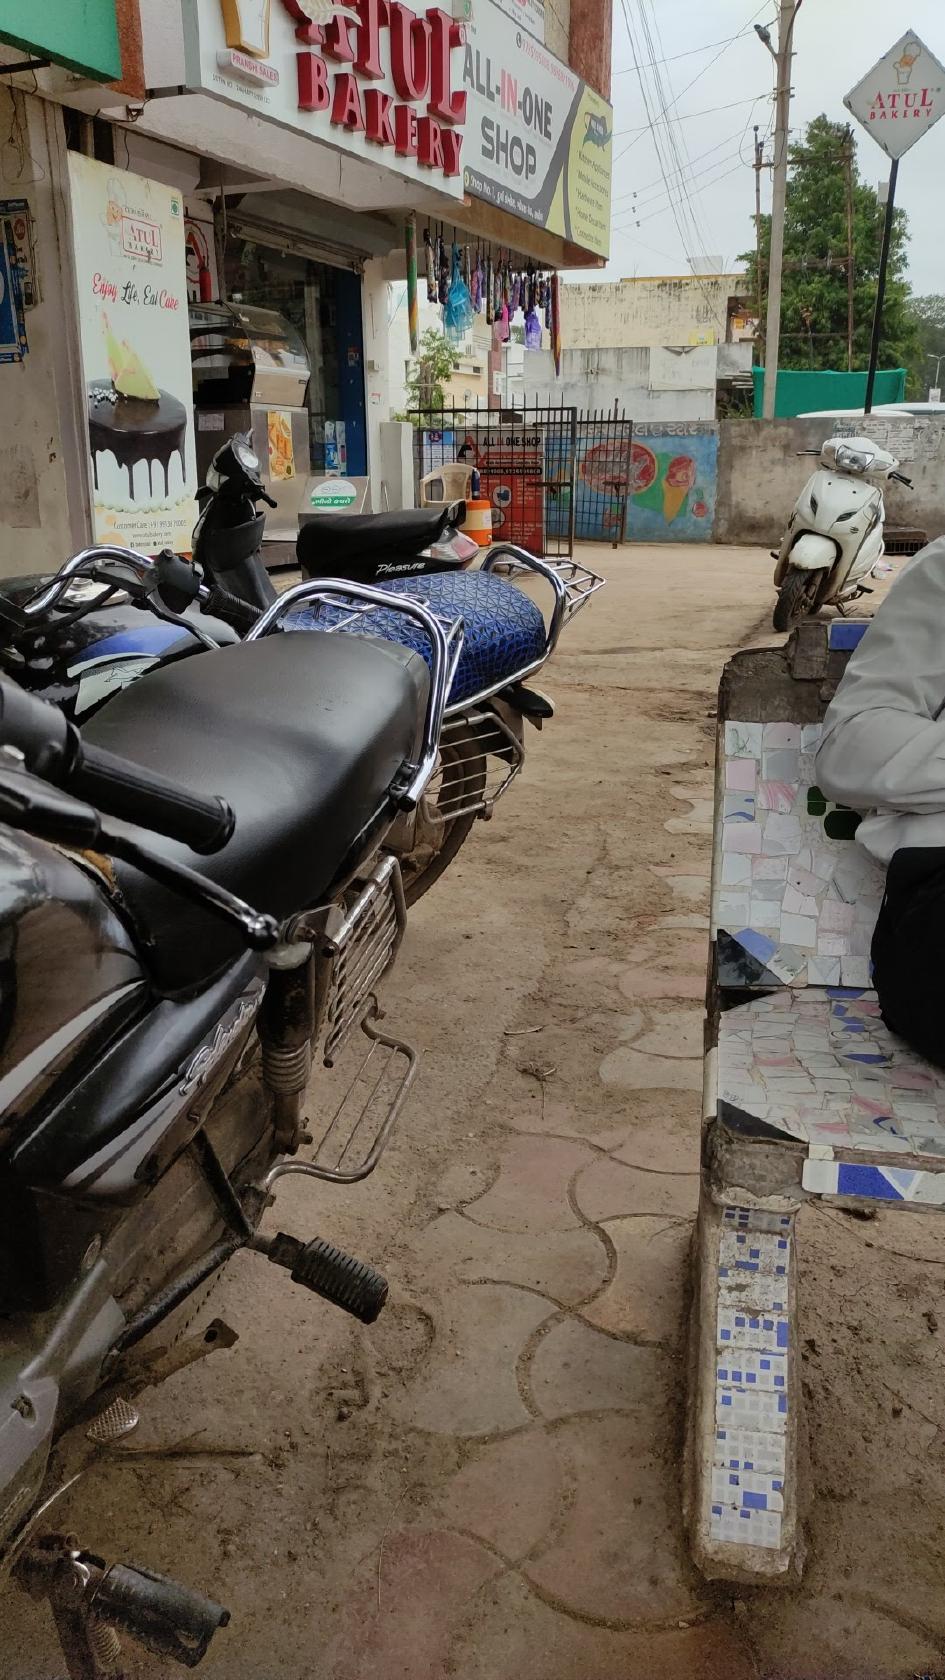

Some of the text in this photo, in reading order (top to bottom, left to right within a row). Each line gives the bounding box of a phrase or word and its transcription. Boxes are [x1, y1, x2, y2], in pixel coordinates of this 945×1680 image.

[463, 42, 552, 141] ALL-IN-ONE
[871, 88, 934, 109] ATUL
[296, 52, 463, 177] BAKERY
[869, 108, 932, 120] BAKERY
[481, 115, 537, 180] SHOP
[128, 224, 159, 248] ATUL
[92, 272, 180, 311] Enjoy Life, Eat Cake
[375, 562, 426, 576] Pleasure
